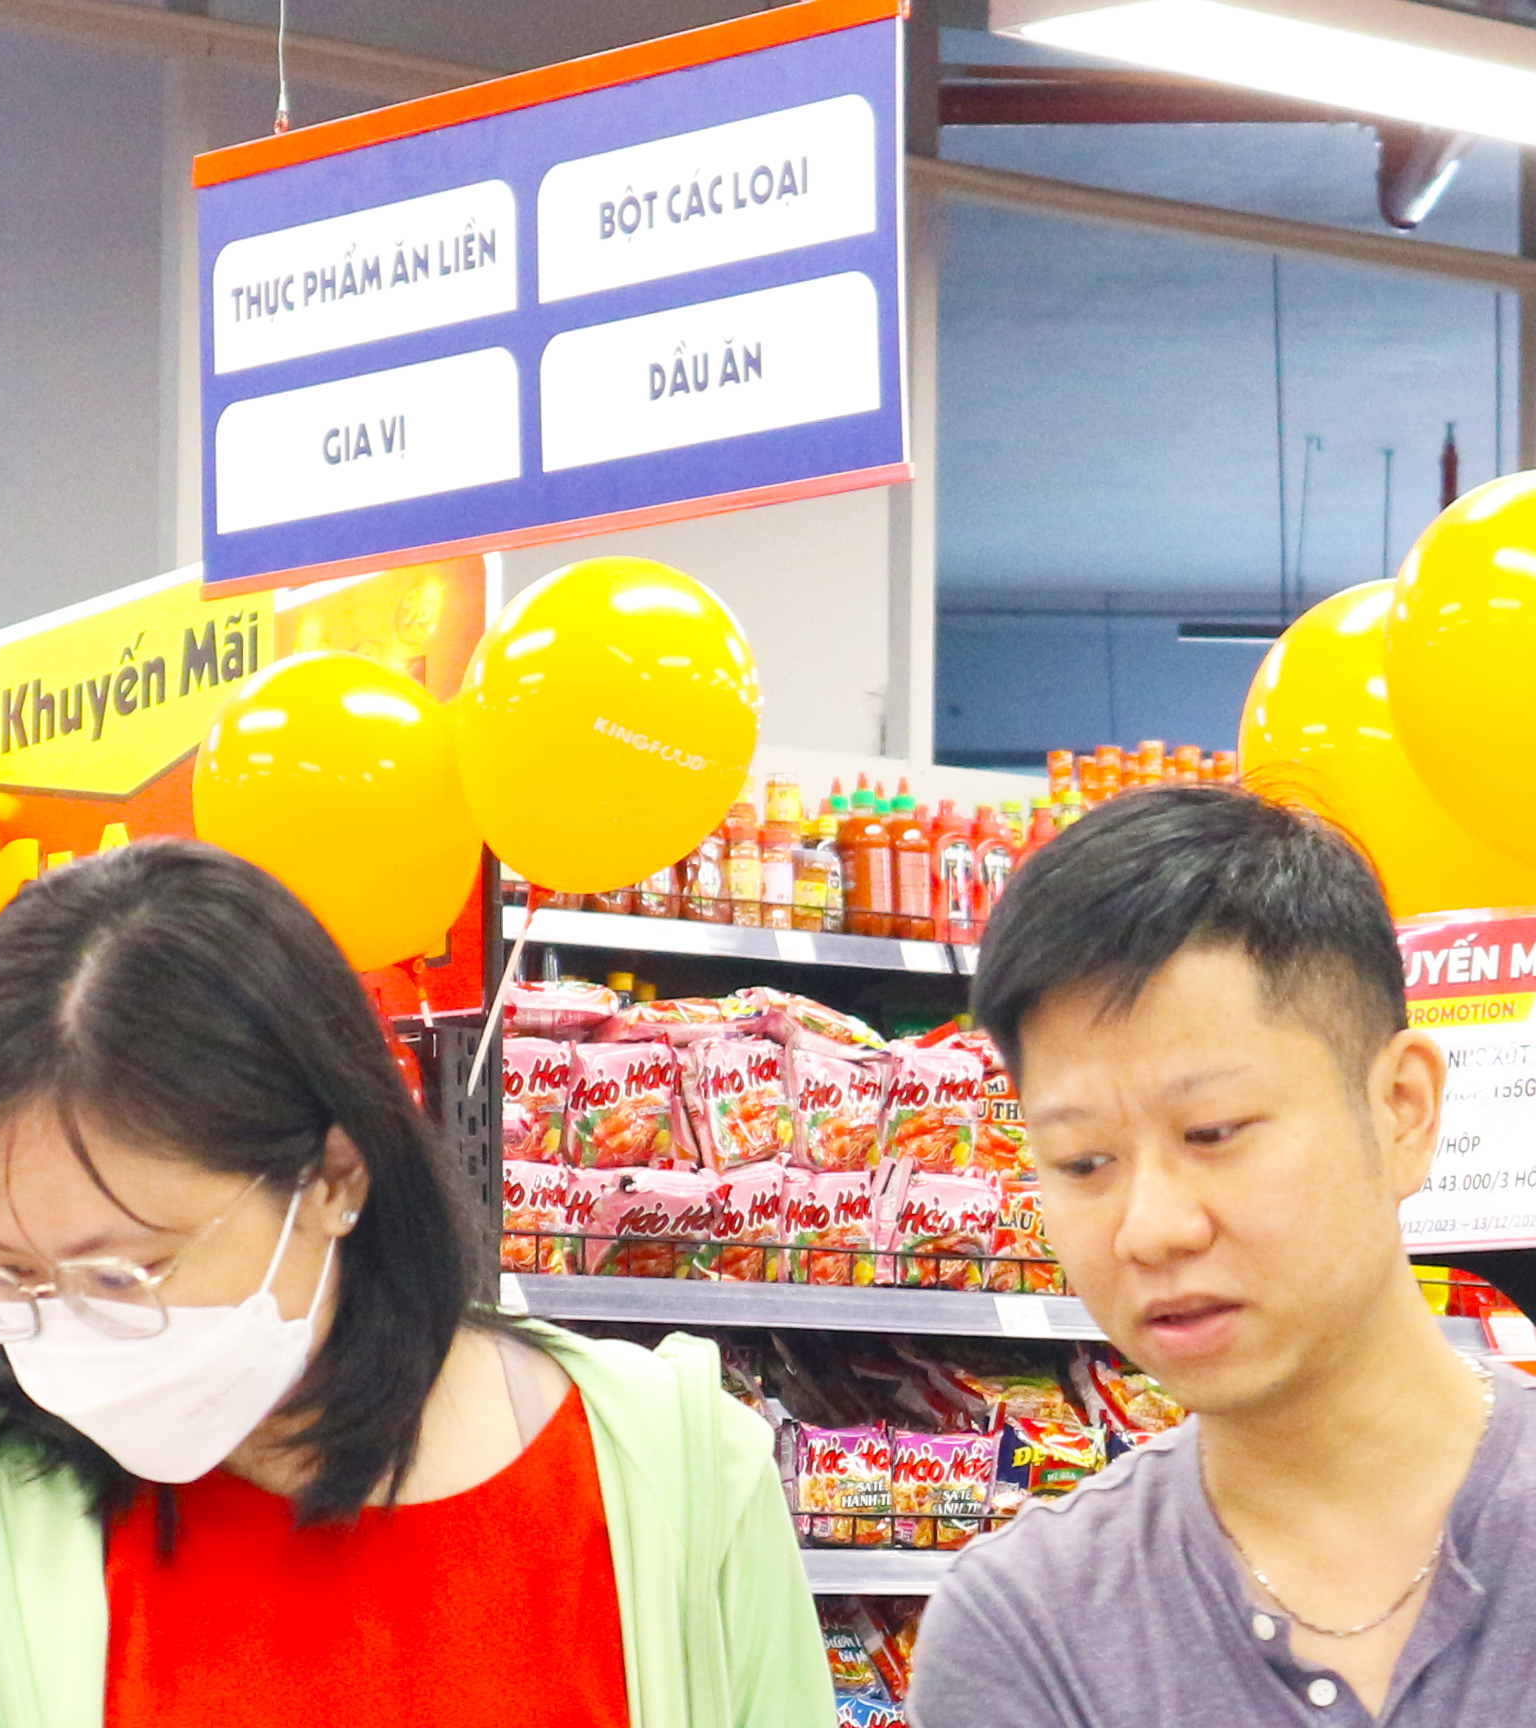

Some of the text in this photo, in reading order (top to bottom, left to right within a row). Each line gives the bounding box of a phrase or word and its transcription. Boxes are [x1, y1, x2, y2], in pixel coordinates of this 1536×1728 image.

[599, 156, 809, 243] BỘT CÁC LOẠI
[231, 216, 498, 326] THỰC PHẨM ĂN LIỀN
[649, 337, 763, 401] DẦU ĂN
[322, 415, 407, 466] GIA VỊ
[0, 611, 261, 755] Khuyến Mãi
[1405, 933, 1500, 990] UYẾN
[571, 1068, 620, 1111] Hảo
[885, 1070, 929, 1110] Hảo
[1438, 1168, 1510, 1193] 43.000/3
[784, 1191, 830, 1233] Hảo
[898, 1196, 954, 1236] Hảo
[895, 1442, 994, 1486] Hảo Hảo
